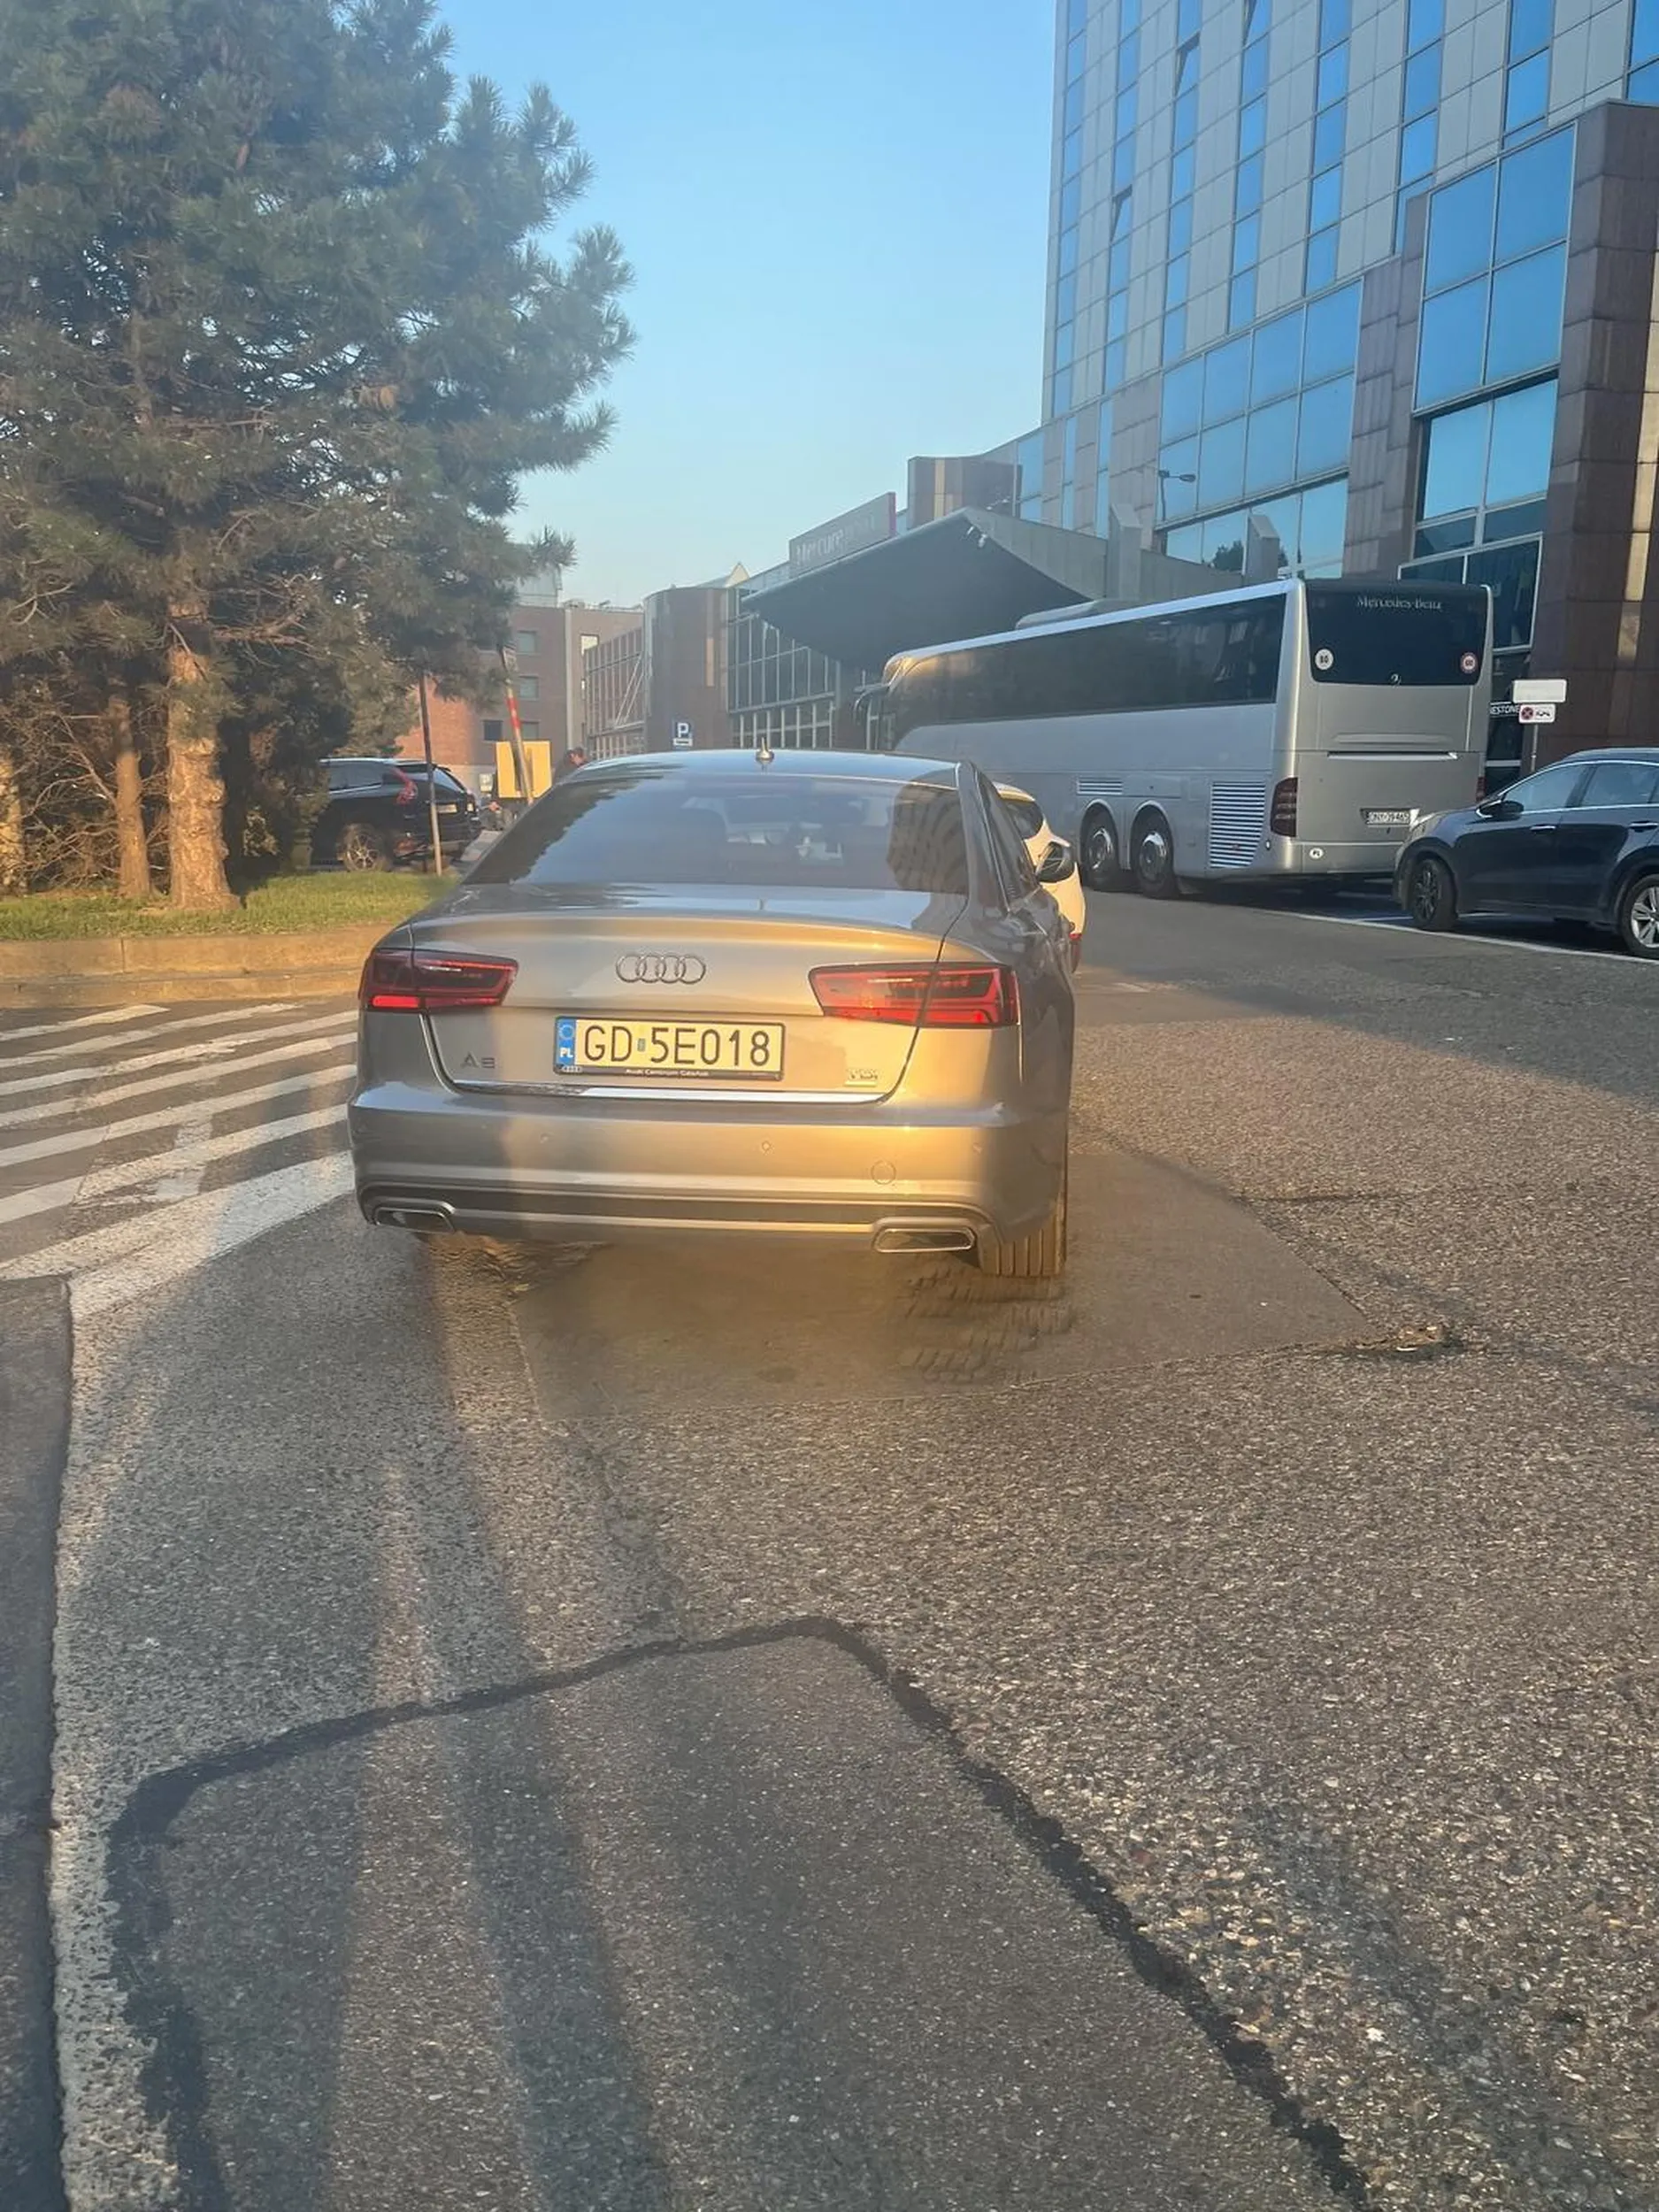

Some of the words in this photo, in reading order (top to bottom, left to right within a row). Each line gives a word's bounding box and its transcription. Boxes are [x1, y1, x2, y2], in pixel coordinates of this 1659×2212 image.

[1357, 595, 1442, 610] Mercedes-Benz
[1489, 705, 1520, 715] ESTONE
[678, 722, 689, 738] P
[559, 1047, 573, 1058] PL
[584, 1025, 633, 1062] GD
[650, 1026, 770, 1067] 5E018
